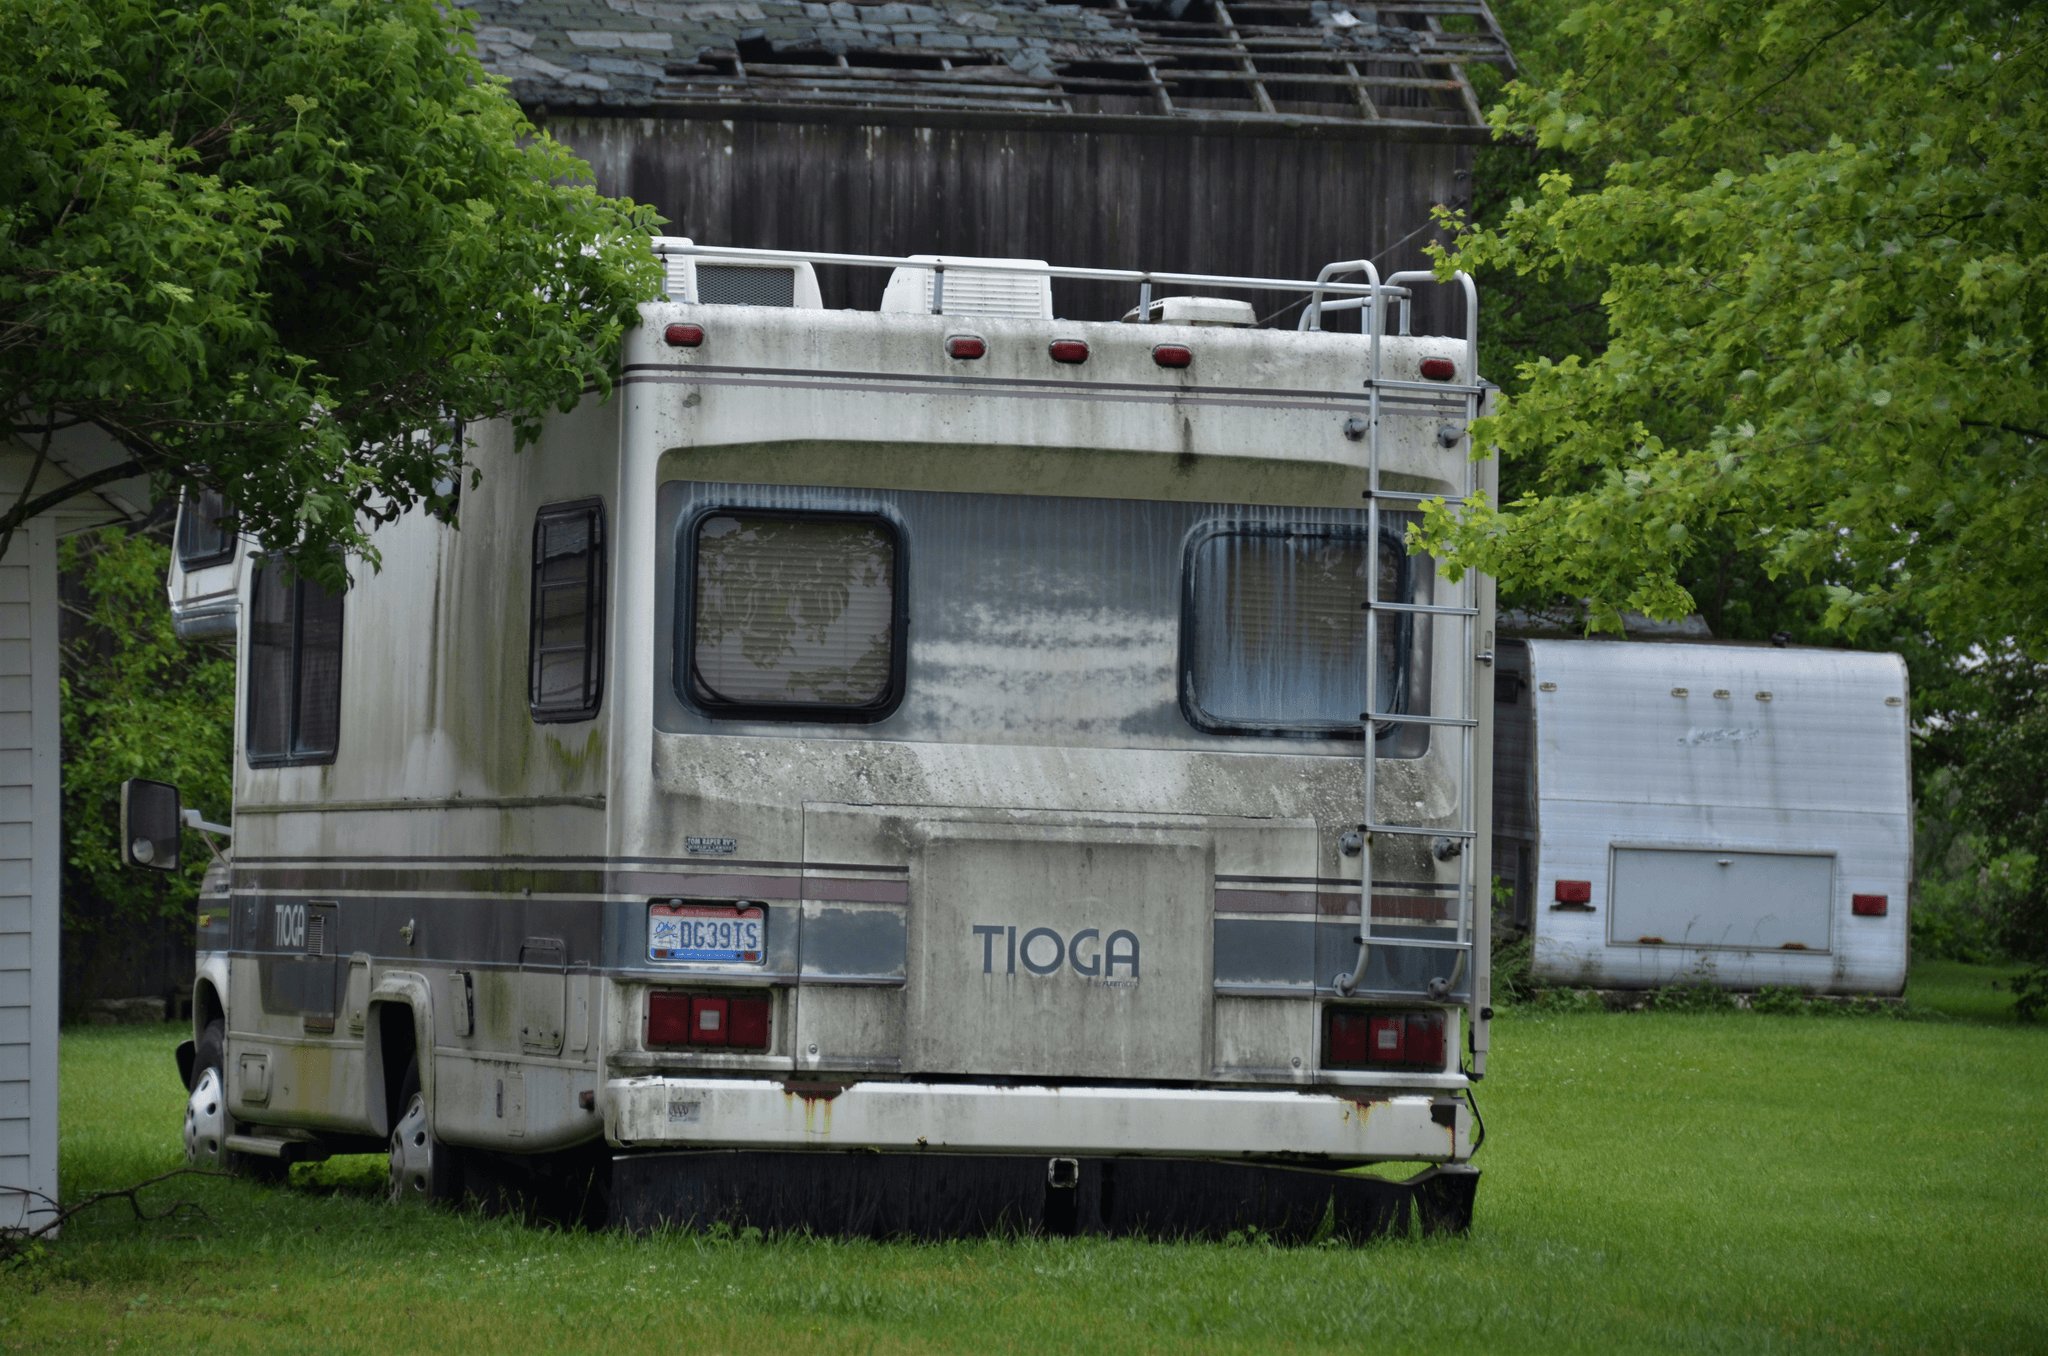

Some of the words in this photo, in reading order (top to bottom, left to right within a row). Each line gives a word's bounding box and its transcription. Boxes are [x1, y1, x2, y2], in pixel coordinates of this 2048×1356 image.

[687, 837, 701, 845] TOM
[702, 837, 721, 846] RAPER
[722, 838, 736, 847] RV'S
[276, 904, 305, 947] TIOGA
[680, 921, 757, 949] DG39TS
[972, 925, 1140, 977] TIOGA
